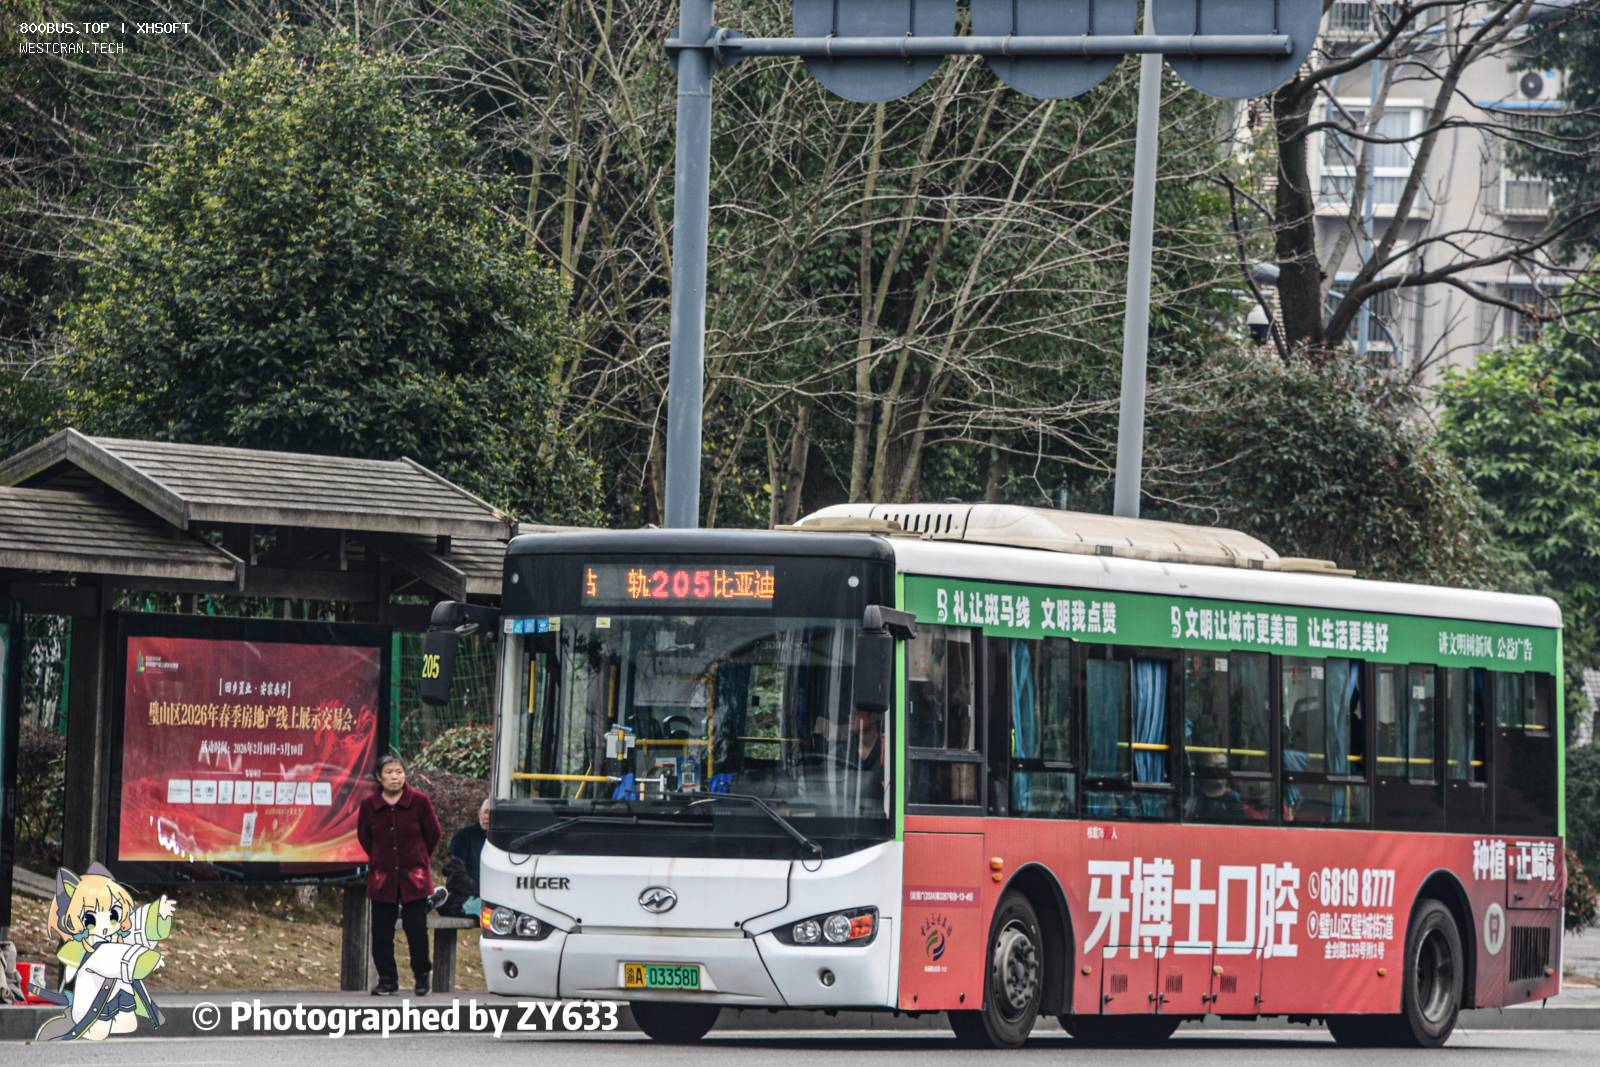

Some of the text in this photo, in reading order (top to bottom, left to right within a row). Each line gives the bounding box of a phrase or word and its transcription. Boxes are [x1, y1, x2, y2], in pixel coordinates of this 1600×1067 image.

[953, 590, 1117, 635] 礼让斑马线 文明我点赞
[1185, 607, 1389, 654] 文明让城市更美丽 让生活更美好
[422, 653, 440, 679] 205
[1497, 636, 1533, 662] 公益广告
[516, 875, 571, 891] HIGER
[1320, 867, 1396, 908] 6819 8777
[1083, 857, 1300, 960] 牙博士口腔
